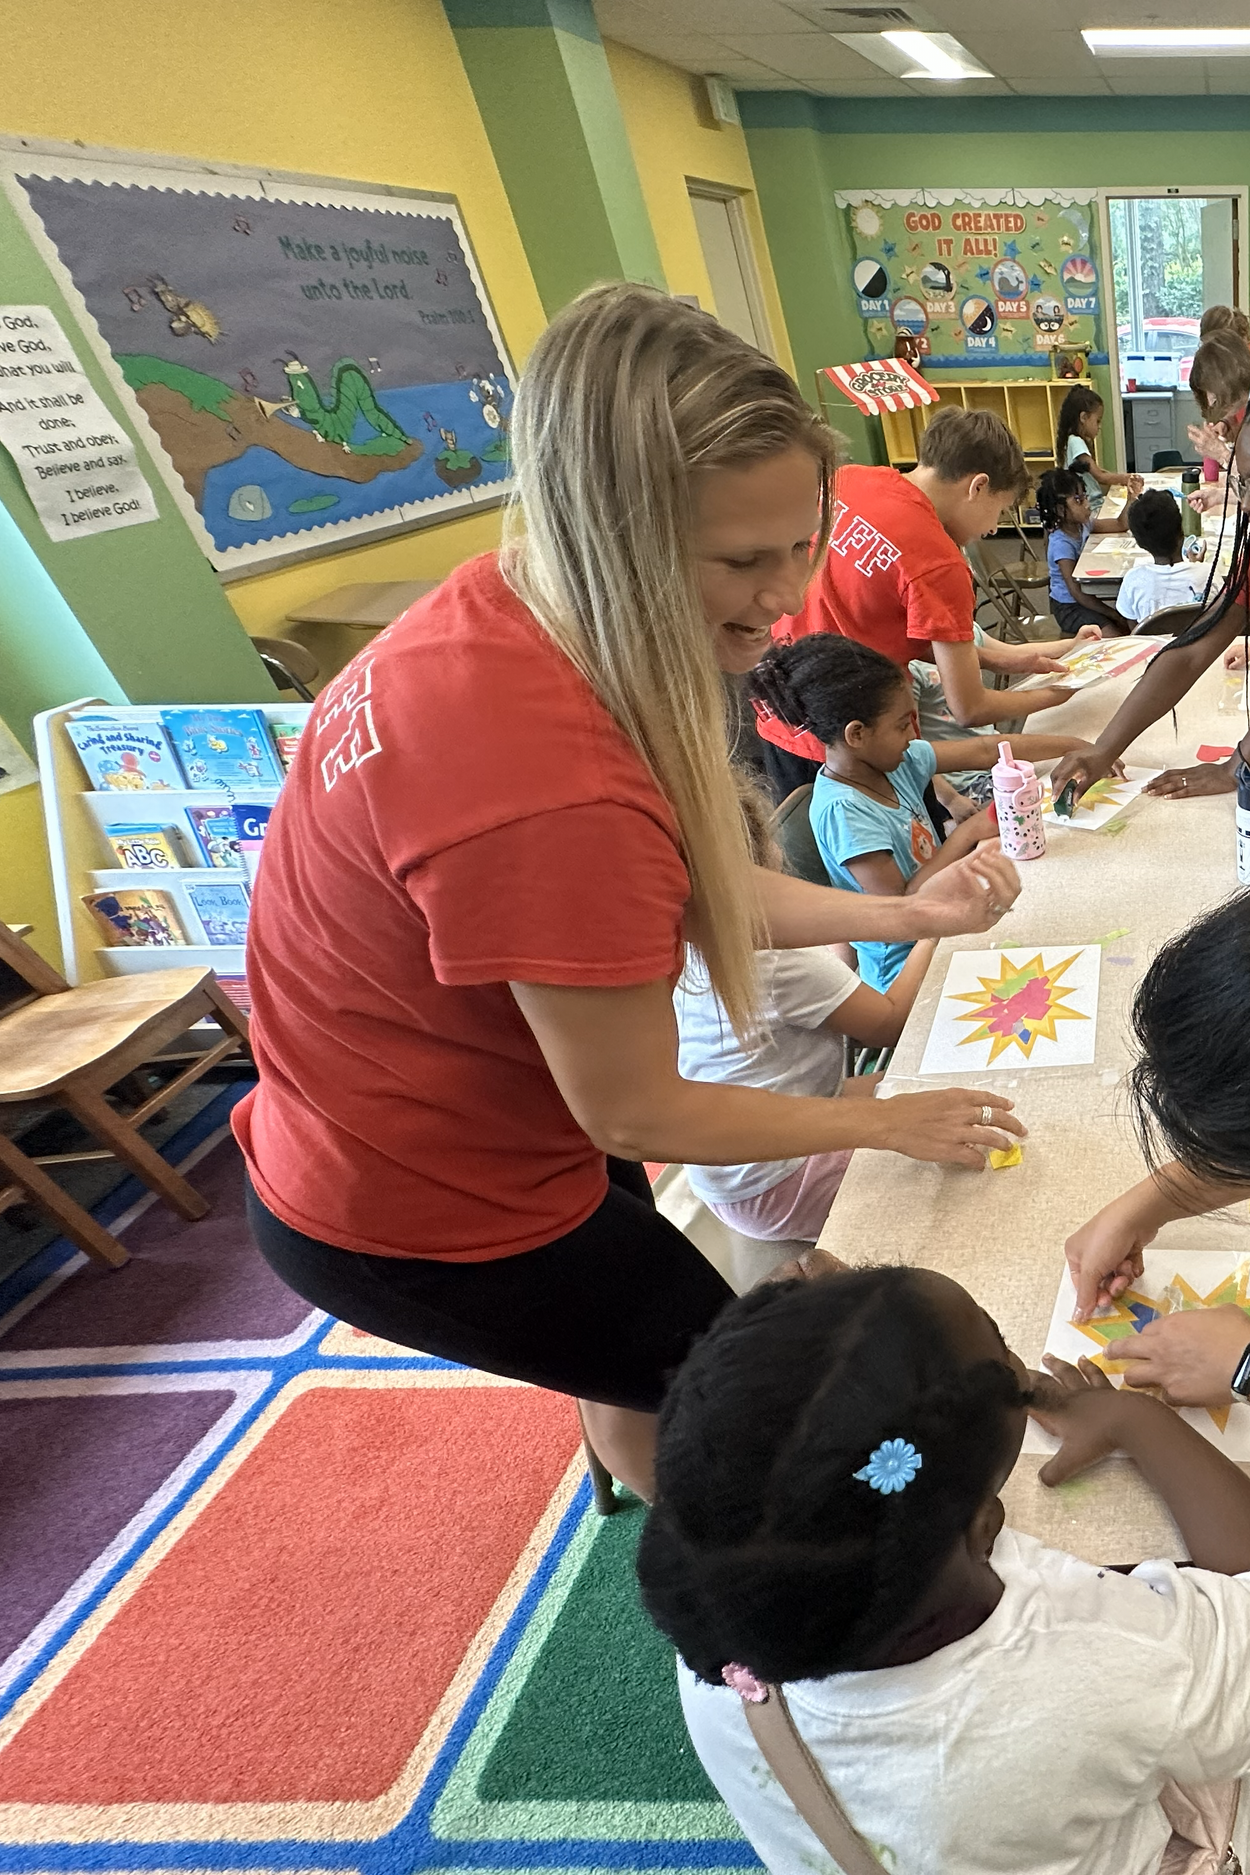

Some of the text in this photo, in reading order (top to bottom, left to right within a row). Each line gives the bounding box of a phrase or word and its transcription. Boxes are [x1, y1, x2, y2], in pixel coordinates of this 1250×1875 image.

[903, 210, 1026, 233] GOD CREATED
[277, 235, 430, 270] Make a joyful noise
[936, 237, 998, 258] IT ALL!
[300, 278, 343, 300] unto
[342, 278, 374, 300] the
[861, 300, 889, 311] DAY 1
[926, 302, 956, 313] DAY 3
[997, 301, 1027, 312] DAY 5
[1067, 297, 1096, 309] DAY 7
[3, 315, 39, 330] God,
[17, 339, 52, 354] God,
[967, 336, 996, 348] DAY 4
[1036, 334, 1066, 345] DAY 6
[26, 364, 51, 376] you
[51, 361, 77, 373] will
[851, 371, 908, 392] GROCERY
[0, 393, 85, 413] And it shall be
[21, 442, 63, 458] Trust
[63, 437, 87, 451] and
[34, 460, 81, 480] Believe
[83, 457, 105, 471] and
[65, 490, 76, 503] I
[60, 499, 142, 526] I believe God!
[77, 731, 162, 751] Caring and Sharing
[99, 744, 144, 757] Treasury
[124, 843, 169, 869] ABC
